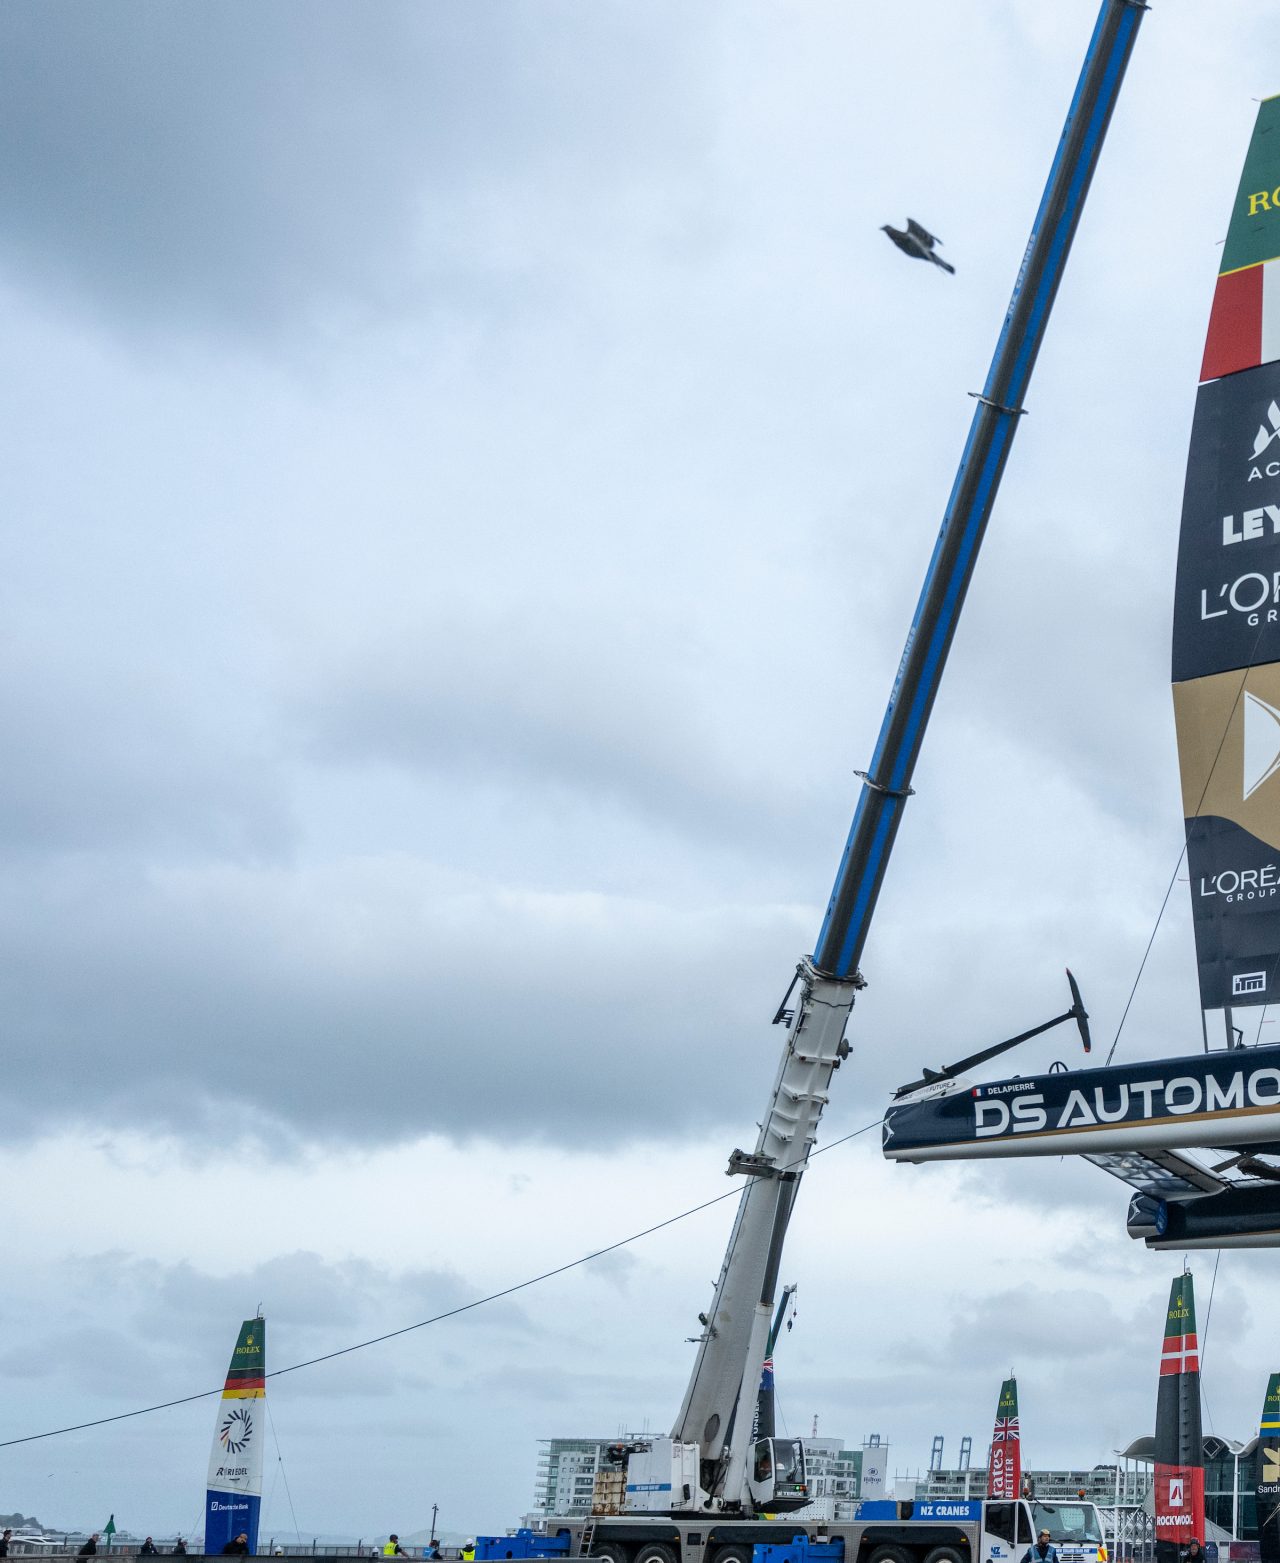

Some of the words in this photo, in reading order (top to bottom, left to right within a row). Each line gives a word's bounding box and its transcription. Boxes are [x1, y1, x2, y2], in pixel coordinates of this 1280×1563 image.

[987, 1082, 1036, 1095] DELAPIERRE
[974, 1094, 1048, 1138] DS
[1168, 1309, 1189, 1319] ROLEX
[236, 1346, 260, 1354] ROLEX
[227, 1467, 248, 1476] RIEDEL
[1005, 1458, 1014, 1498] BETTER
[921, 1506, 933, 1516] NZ
[935, 1506, 970, 1516] CRANES
[1156, 1514, 1193, 1526] ROCKWOOL
